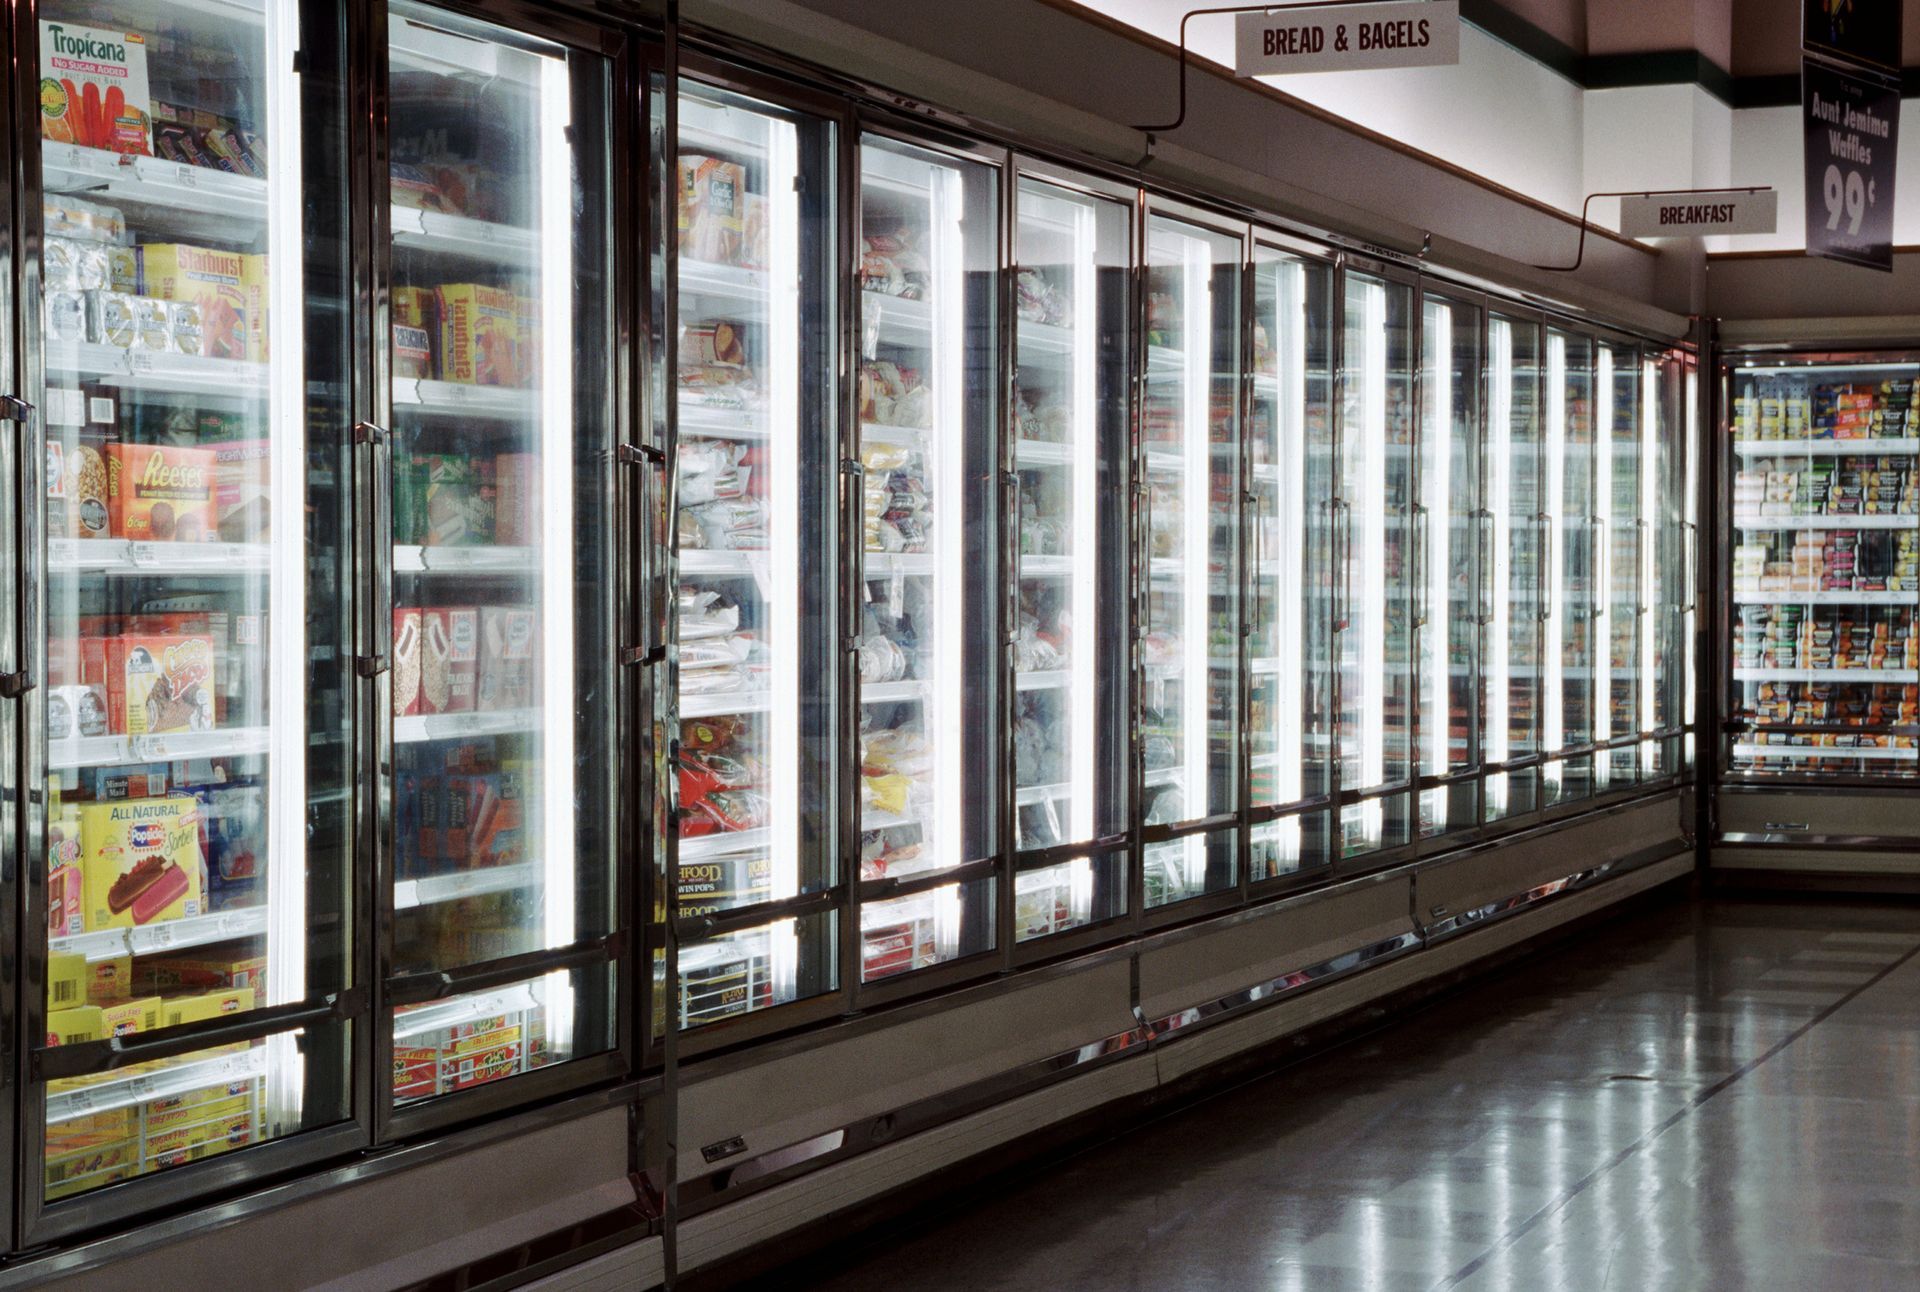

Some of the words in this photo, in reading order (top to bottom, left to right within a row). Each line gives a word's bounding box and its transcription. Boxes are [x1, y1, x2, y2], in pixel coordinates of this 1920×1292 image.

[48, 25, 126, 62] Tropicana
[1263, 26, 1324, 56] BREAD
[1334, 24, 1349, 52] &
[1359, 19, 1430, 50] BAGELS
[69, 61, 96, 73] SUGAR
[97, 65, 126, 76] ADDED
[1812, 91, 1840, 124] Aunt
[1843, 101, 1889, 138] Jemima
[1829, 129, 1871, 165] Waffles
[1660, 204, 1735, 225] BREAKFAST
[178, 246, 243, 278] Starburst
[106, 779, 128, 789] Minute
[109, 788, 126, 797] Maid
[111, 807, 130, 821] ALL
[133, 805, 180, 819] NATURAL
[679, 865, 722, 881] HFOOD
[679, 885, 694, 893] WIN
[695, 883, 715, 892] POPS
[107, 1011, 127, 1021] SUGAR
[127, 1007, 143, 1017] FREE
